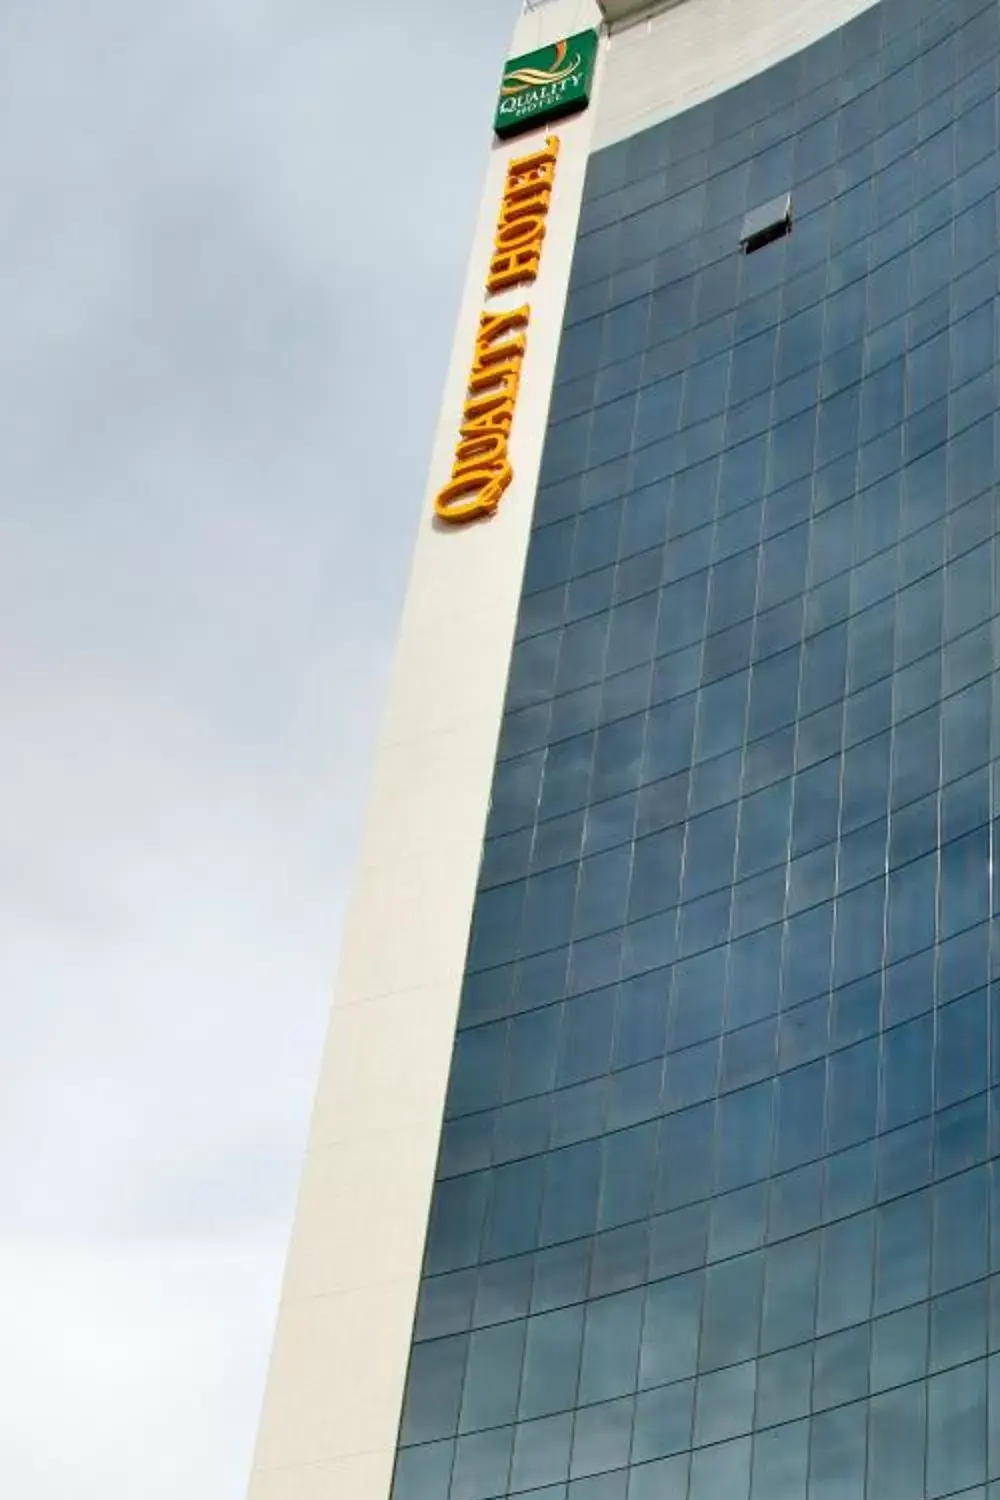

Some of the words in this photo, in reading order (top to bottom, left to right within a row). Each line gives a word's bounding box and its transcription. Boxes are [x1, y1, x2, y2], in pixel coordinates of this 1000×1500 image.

[499, 73, 583, 113] QUALITY
[515, 93, 561, 117] HOTEL
[434, 304, 531, 523] QUALITY
[486, 134, 560, 293] HOTEL
